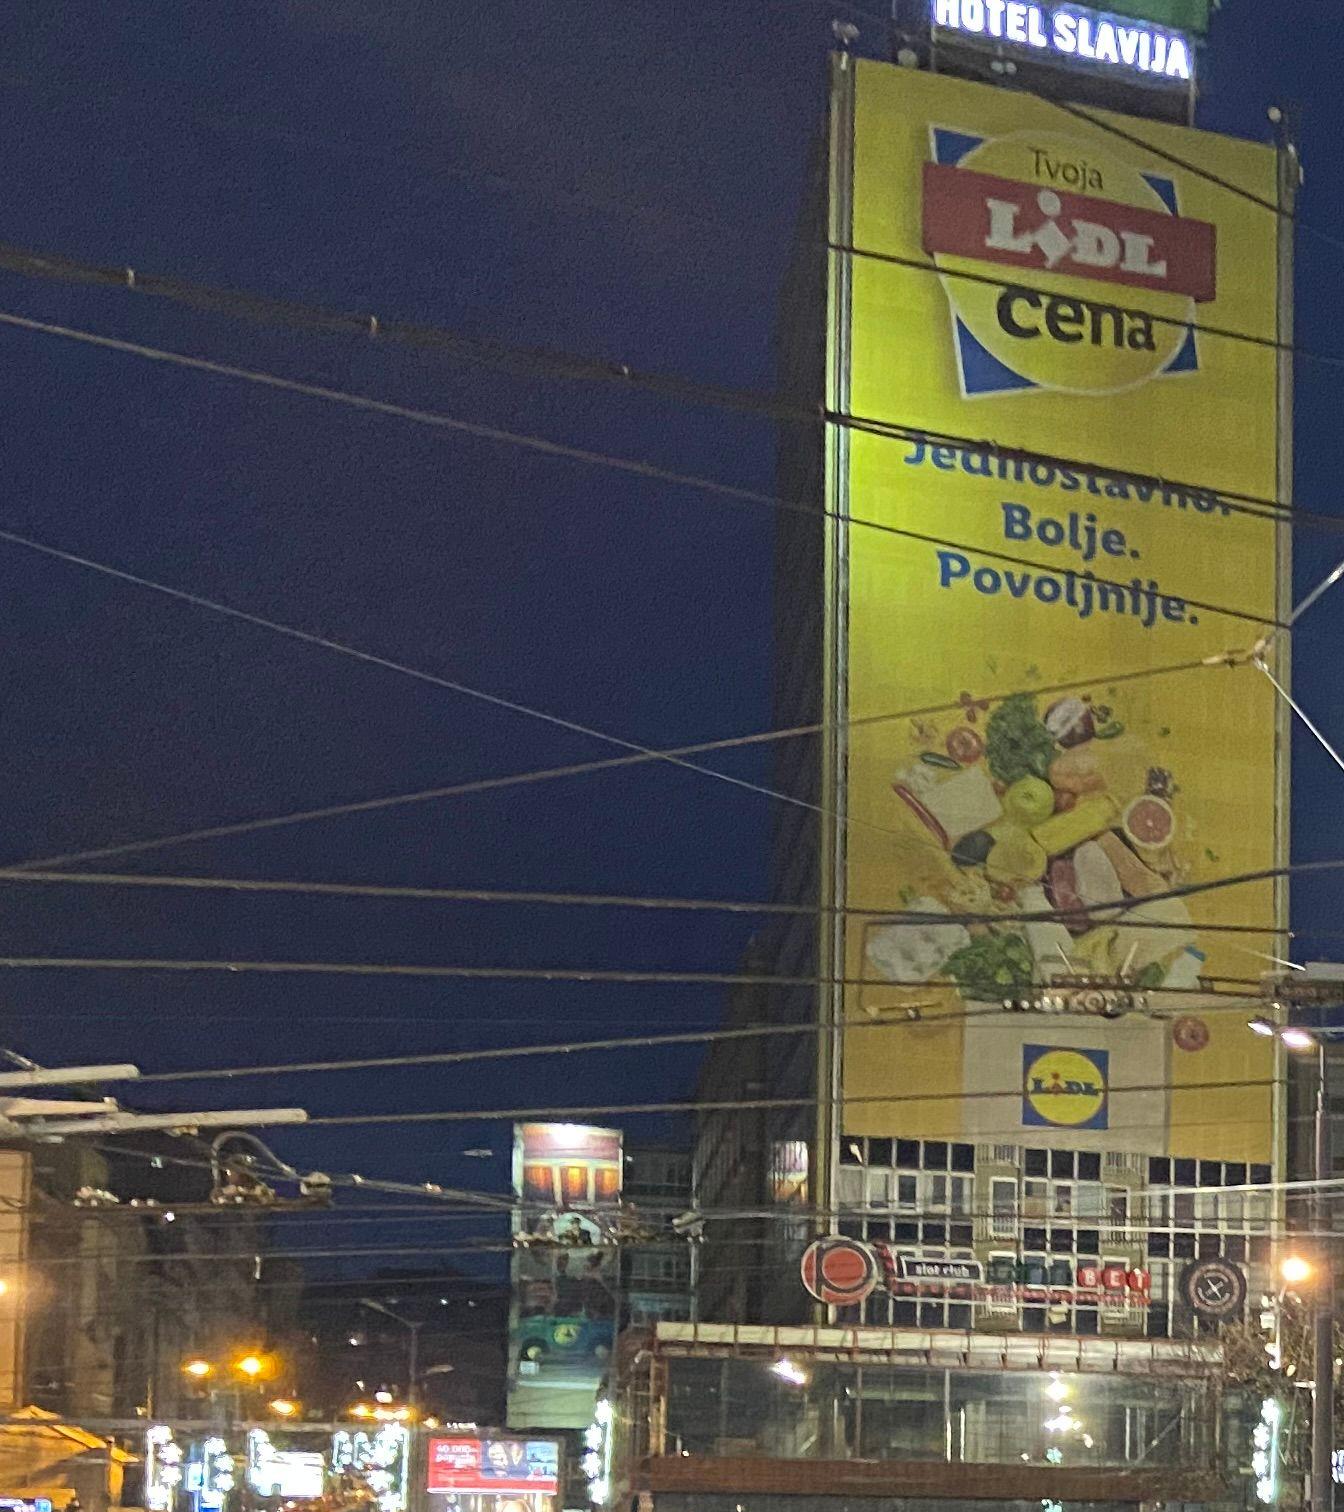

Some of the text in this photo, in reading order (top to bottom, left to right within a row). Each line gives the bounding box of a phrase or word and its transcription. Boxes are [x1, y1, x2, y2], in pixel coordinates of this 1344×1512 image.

[934, 0, 1191, 80] HOTEL SLAVIJA
[1028, 146, 1104, 191] Tvoja
[996, 285, 1157, 351] cena
[1001, 501, 1140, 562] Bolje.
[936, 550, 1199, 628] Povoljnije.
